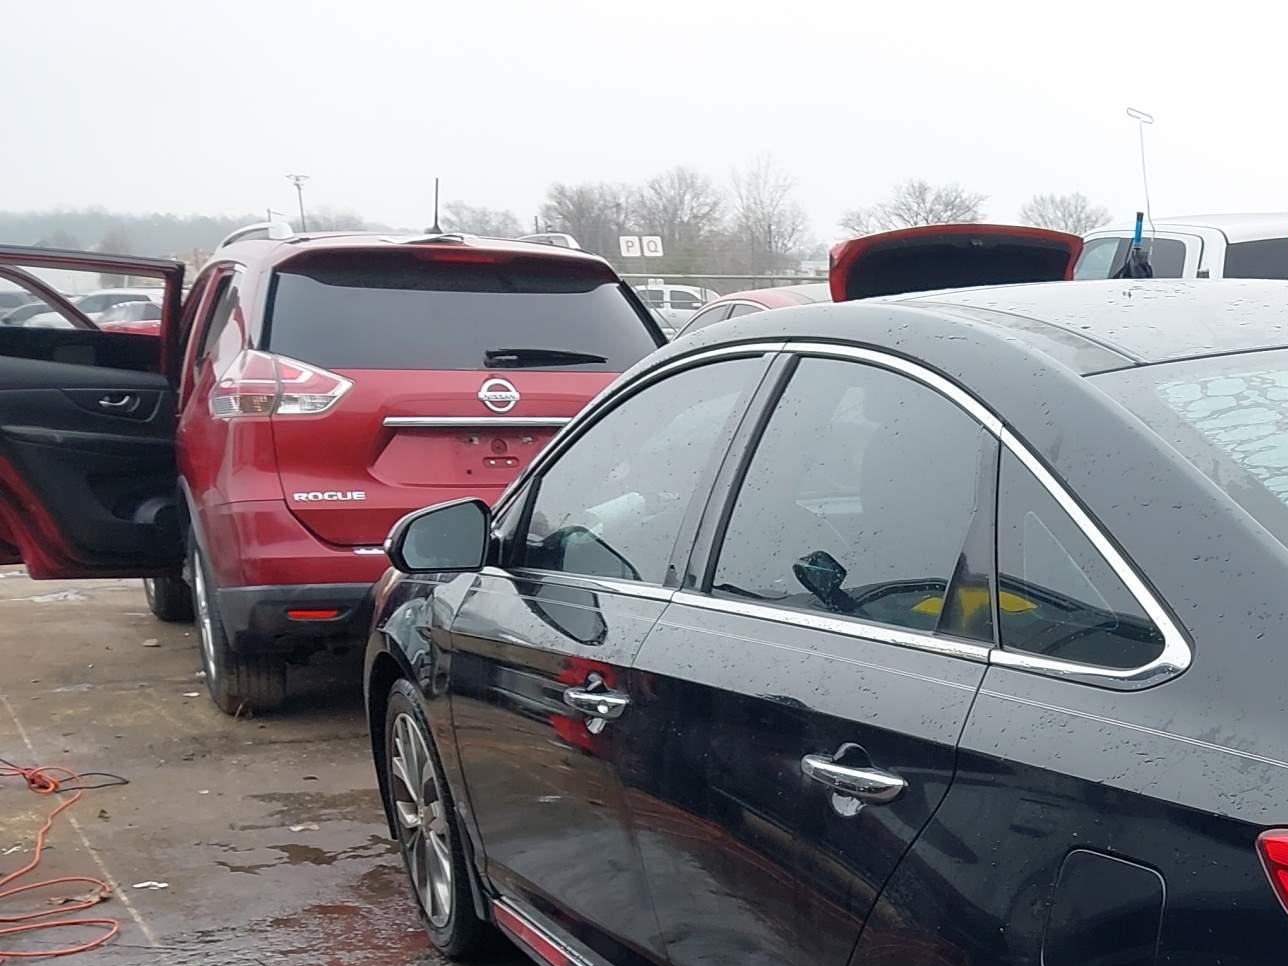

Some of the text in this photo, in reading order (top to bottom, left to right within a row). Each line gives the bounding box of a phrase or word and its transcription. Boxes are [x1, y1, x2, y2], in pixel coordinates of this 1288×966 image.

[625, 240, 635, 253] P
[647, 240, 659, 253] Q
[293, 491, 367, 502] ROGUE
